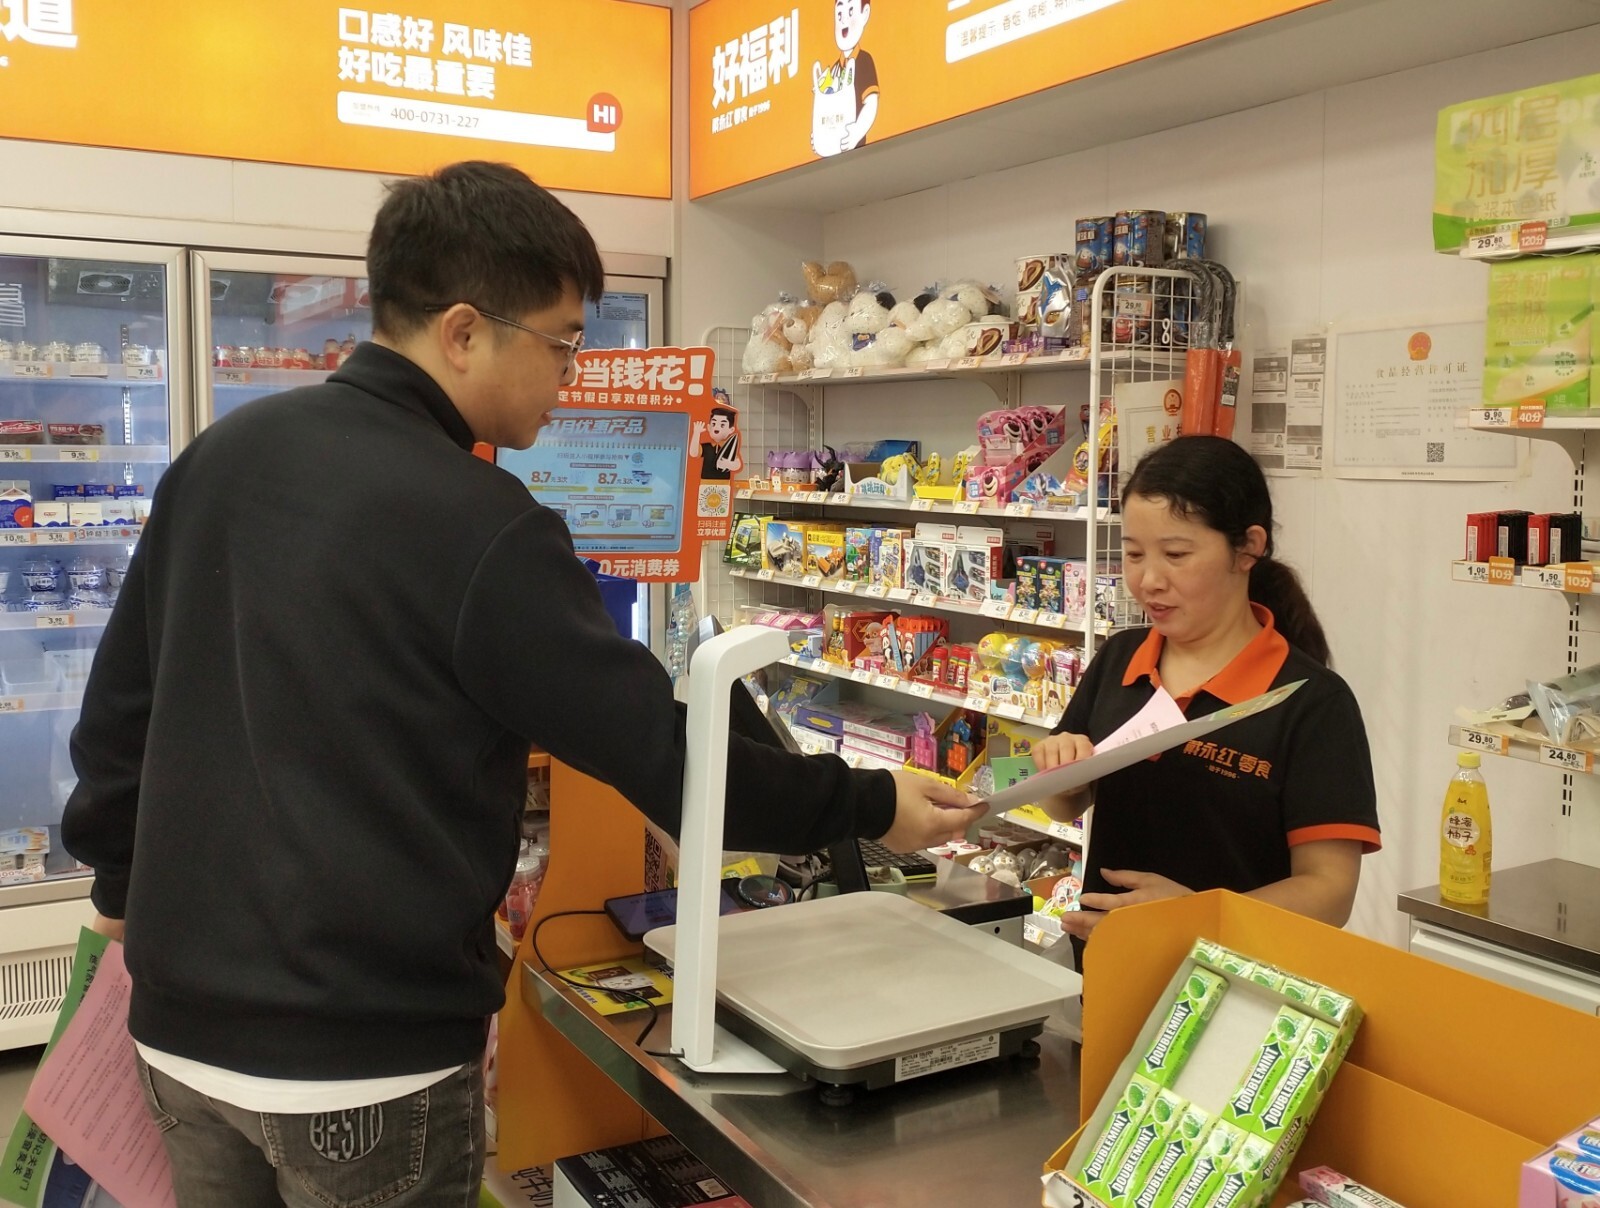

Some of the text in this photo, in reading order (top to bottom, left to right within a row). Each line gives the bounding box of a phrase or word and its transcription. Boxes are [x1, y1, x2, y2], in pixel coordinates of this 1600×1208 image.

[338, 7, 533, 68] 口感好 风味佳
[712, 8, 799, 110] 好福利
[337, 46, 495, 100] 好吃最重要
[593, 103, 616, 125] HI
[1477, 235, 1544, 249] 29.80 120分
[1376, 362, 1469, 379] 食品经营许可证
[1484, 411, 1542, 423] 9.90 40分
[697, 519, 727, 529] 扫码注册
[1468, 566, 1513, 581] 1.00 10分
[1539, 572, 1592, 588] 1.50 10分
[1468, 732, 1493, 745] 29.80
[1548, 749, 1577, 762] 24.80
[1238, 753, 1273, 779] 零食
[1449, 816, 1473, 827] 蜂蜜
[1447, 830, 1473, 842] 柚子
[1148, 1002, 1191, 1069] DOUBLEMINT
[1235, 1045, 1282, 1115] DOUBLEMINT
[1263, 1056, 1313, 1132] DOUBLEMINT
[1086, 1114, 1129, 1179] DOUBLEMINT
[1112, 1127, 1155, 1194] DOUBLEMINT
